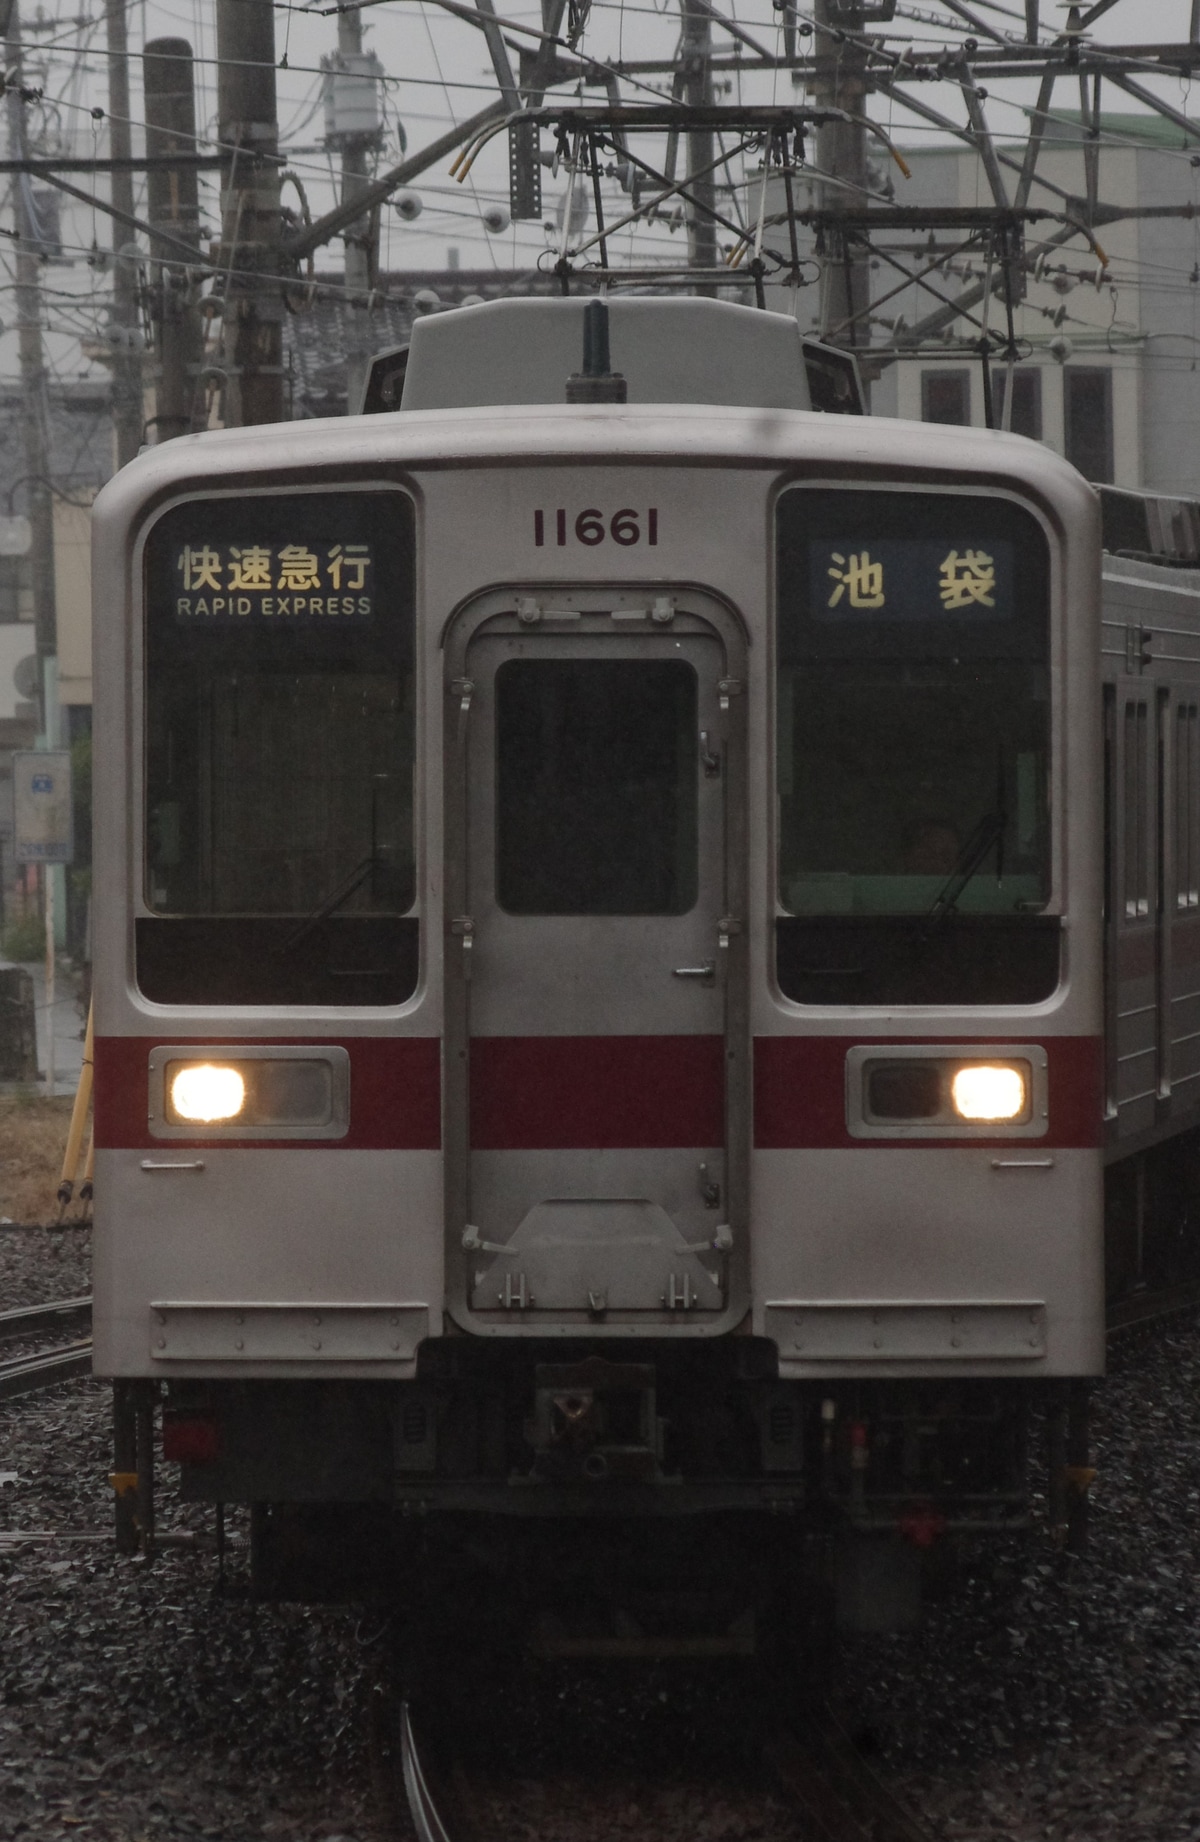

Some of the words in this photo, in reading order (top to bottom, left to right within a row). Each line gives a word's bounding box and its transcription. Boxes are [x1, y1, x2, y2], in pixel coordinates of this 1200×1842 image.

[534, 507, 659, 547] 11661
[177, 543, 371, 591] 快速急行
[176, 597, 252, 616] RAPID
[261, 596, 371, 616] EXPRESS
